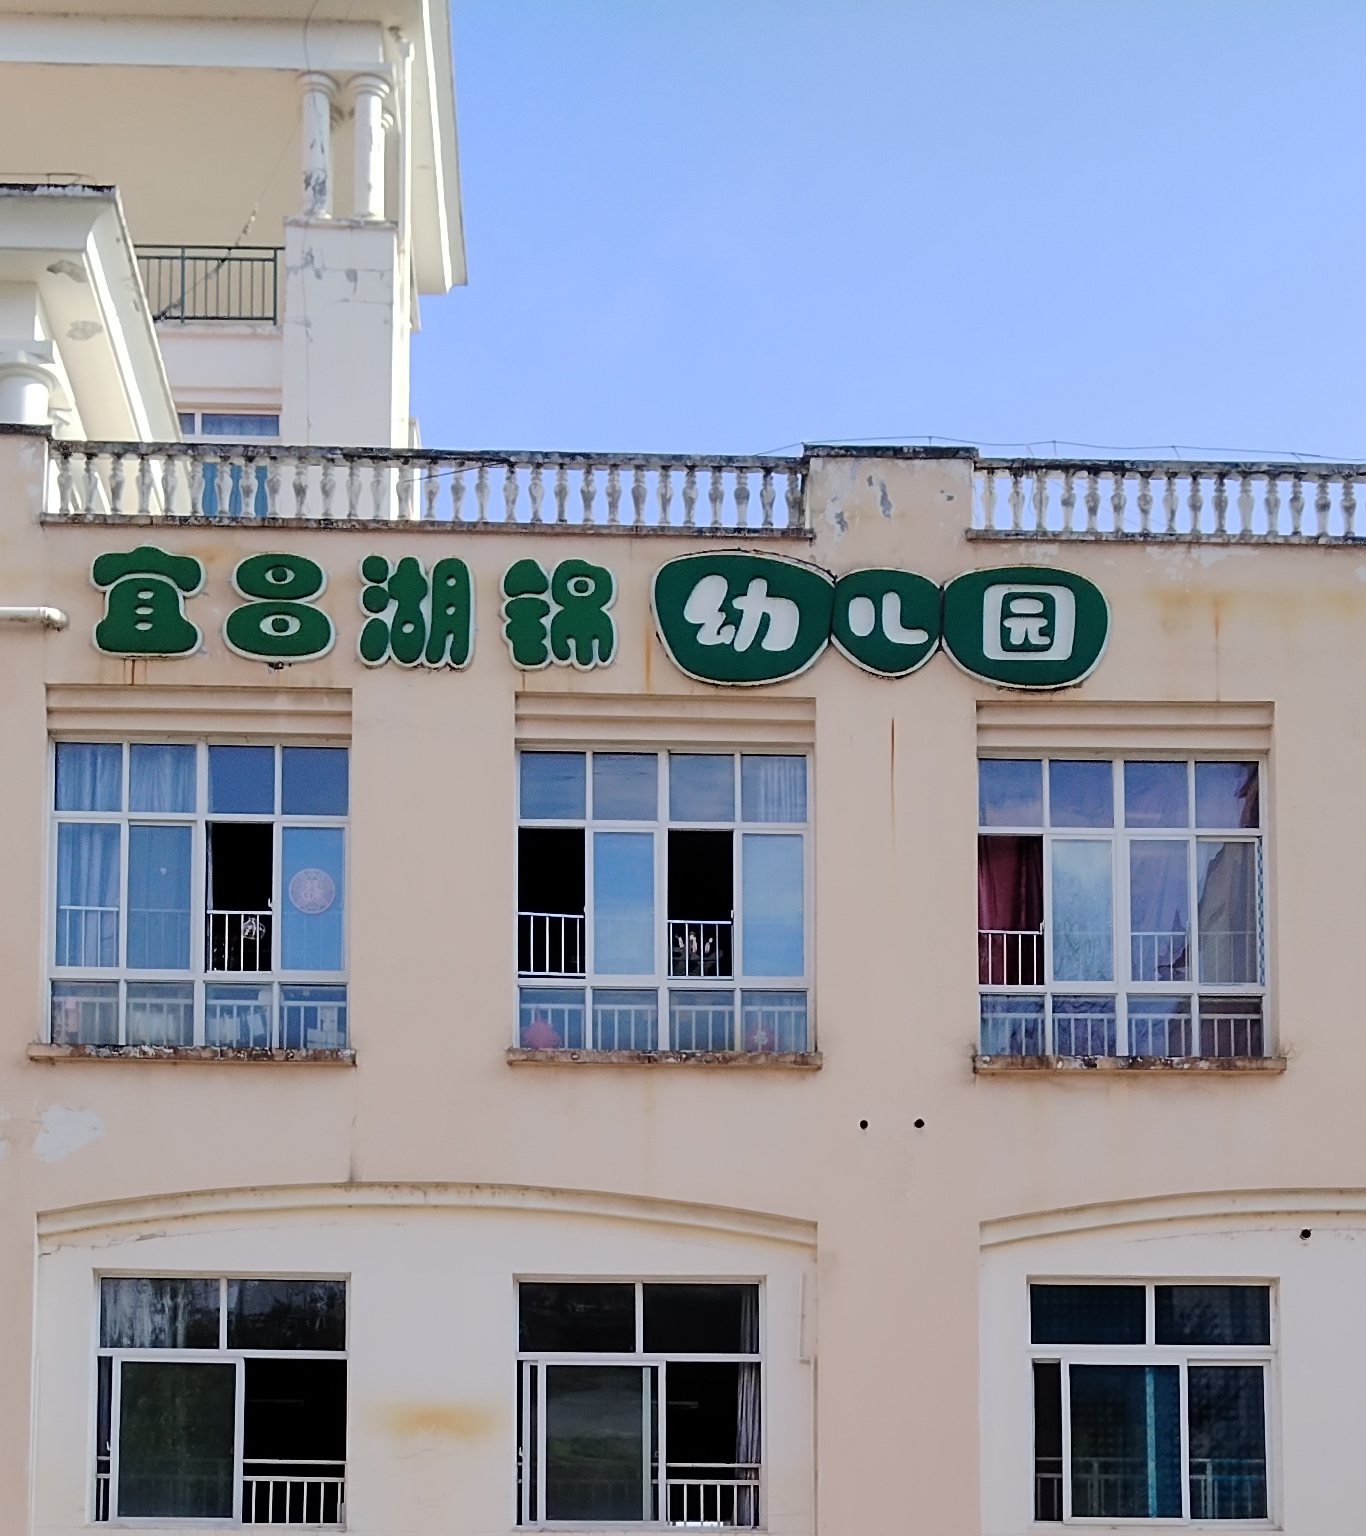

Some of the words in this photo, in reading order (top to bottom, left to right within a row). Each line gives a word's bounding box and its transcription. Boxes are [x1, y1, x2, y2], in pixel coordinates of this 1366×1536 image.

[90, 545, 1085, 676] 宜昌湖锦幼儿园
